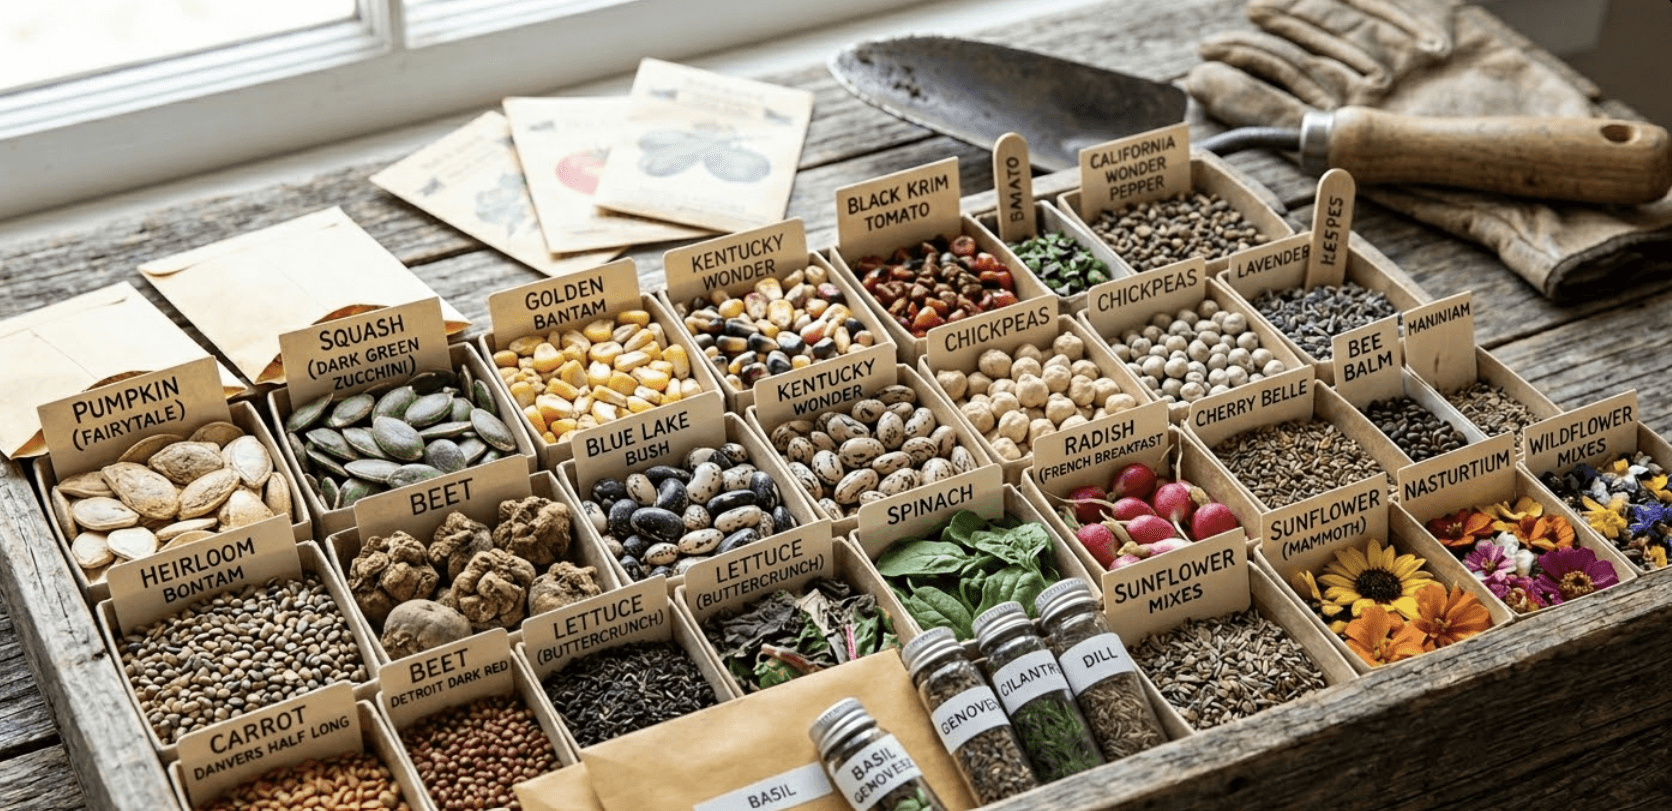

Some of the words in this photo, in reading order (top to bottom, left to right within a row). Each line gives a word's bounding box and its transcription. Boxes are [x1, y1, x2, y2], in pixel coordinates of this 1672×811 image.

[1090, 135, 1176, 170] CALIFORNIA
[1105, 156, 1166, 184] WONDER
[846, 187, 901, 215] BLACK
[906, 175, 949, 199] KRIM
[1109, 175, 1165, 201] PEPPER
[864, 202, 930, 232] TOMATO
[691, 233, 785, 273] KENTUCKY
[524, 276, 605, 311] GOLDEN
[702, 258, 776, 291] WONDER
[1096, 268, 1198, 313] CHICKPEAS
[319, 315, 405, 351] SQUASH
[533, 299, 607, 331] BANTAM
[944, 306, 1051, 353] CHICKPEAS
[308, 353, 361, 380] (DARK
[365, 337, 420, 363] GREEN
[1348, 332, 1383, 358] BEE
[332, 354, 417, 391] ZUCCHINI)
[777, 358, 876, 402] KENTUCKY
[1344, 350, 1393, 383] BALM
[72, 376, 180, 423] PUMPKIN
[793, 385, 863, 416] WONDER
[1195, 395, 1256, 428] CHERRY
[1261, 380, 1308, 407] BELLE
[72, 400, 186, 451] (FAIRYTALE)
[586, 422, 639, 457] BLUE
[642, 411, 690, 441] LAKE
[1064, 420, 1135, 456] RADISH
[1528, 406, 1633, 456] WILDFLOWER
[625, 440, 670, 467] BUSH
[1038, 455, 1093, 485] (FRENCH
[1095, 434, 1164, 467] BREAKFAST
[1557, 438, 1607, 469] MIXES
[1404, 450, 1510, 501] NASTURTIUM
[410, 478, 473, 516] BEET
[886, 484, 975, 526] SPINACH
[1269, 488, 1380, 541] SUNFLOWER
[1281, 518, 1367, 561] (MAMMOTH)
[141, 537, 255, 588] HEIRLOOM
[715, 539, 804, 583] LETTUCE
[1113, 549, 1236, 605] SUNFLOWER
[162, 566, 244, 604] BONTAM
[695, 555, 825, 610] (BUTTERCRUNCH)
[1147, 586, 1204, 615] MIXES
[536, 608, 664, 666] (BUTTERCRUNCH)
[552, 594, 645, 640] LETTUCE
[409, 648, 468, 683] BEET
[1083, 646, 1119, 669] DILL
[390, 678, 445, 708] DETROIT
[447, 668, 482, 690] DARK
[484, 660, 509, 681] RED
[193, 746, 264, 781] DANVERS
[267, 732, 306, 756] HALF
[310, 716, 350, 739] LONG
[209, 705, 308, 754] CARROT
[850, 747, 897, 782] BASIL
[747, 784, 797, 809] BASIL
